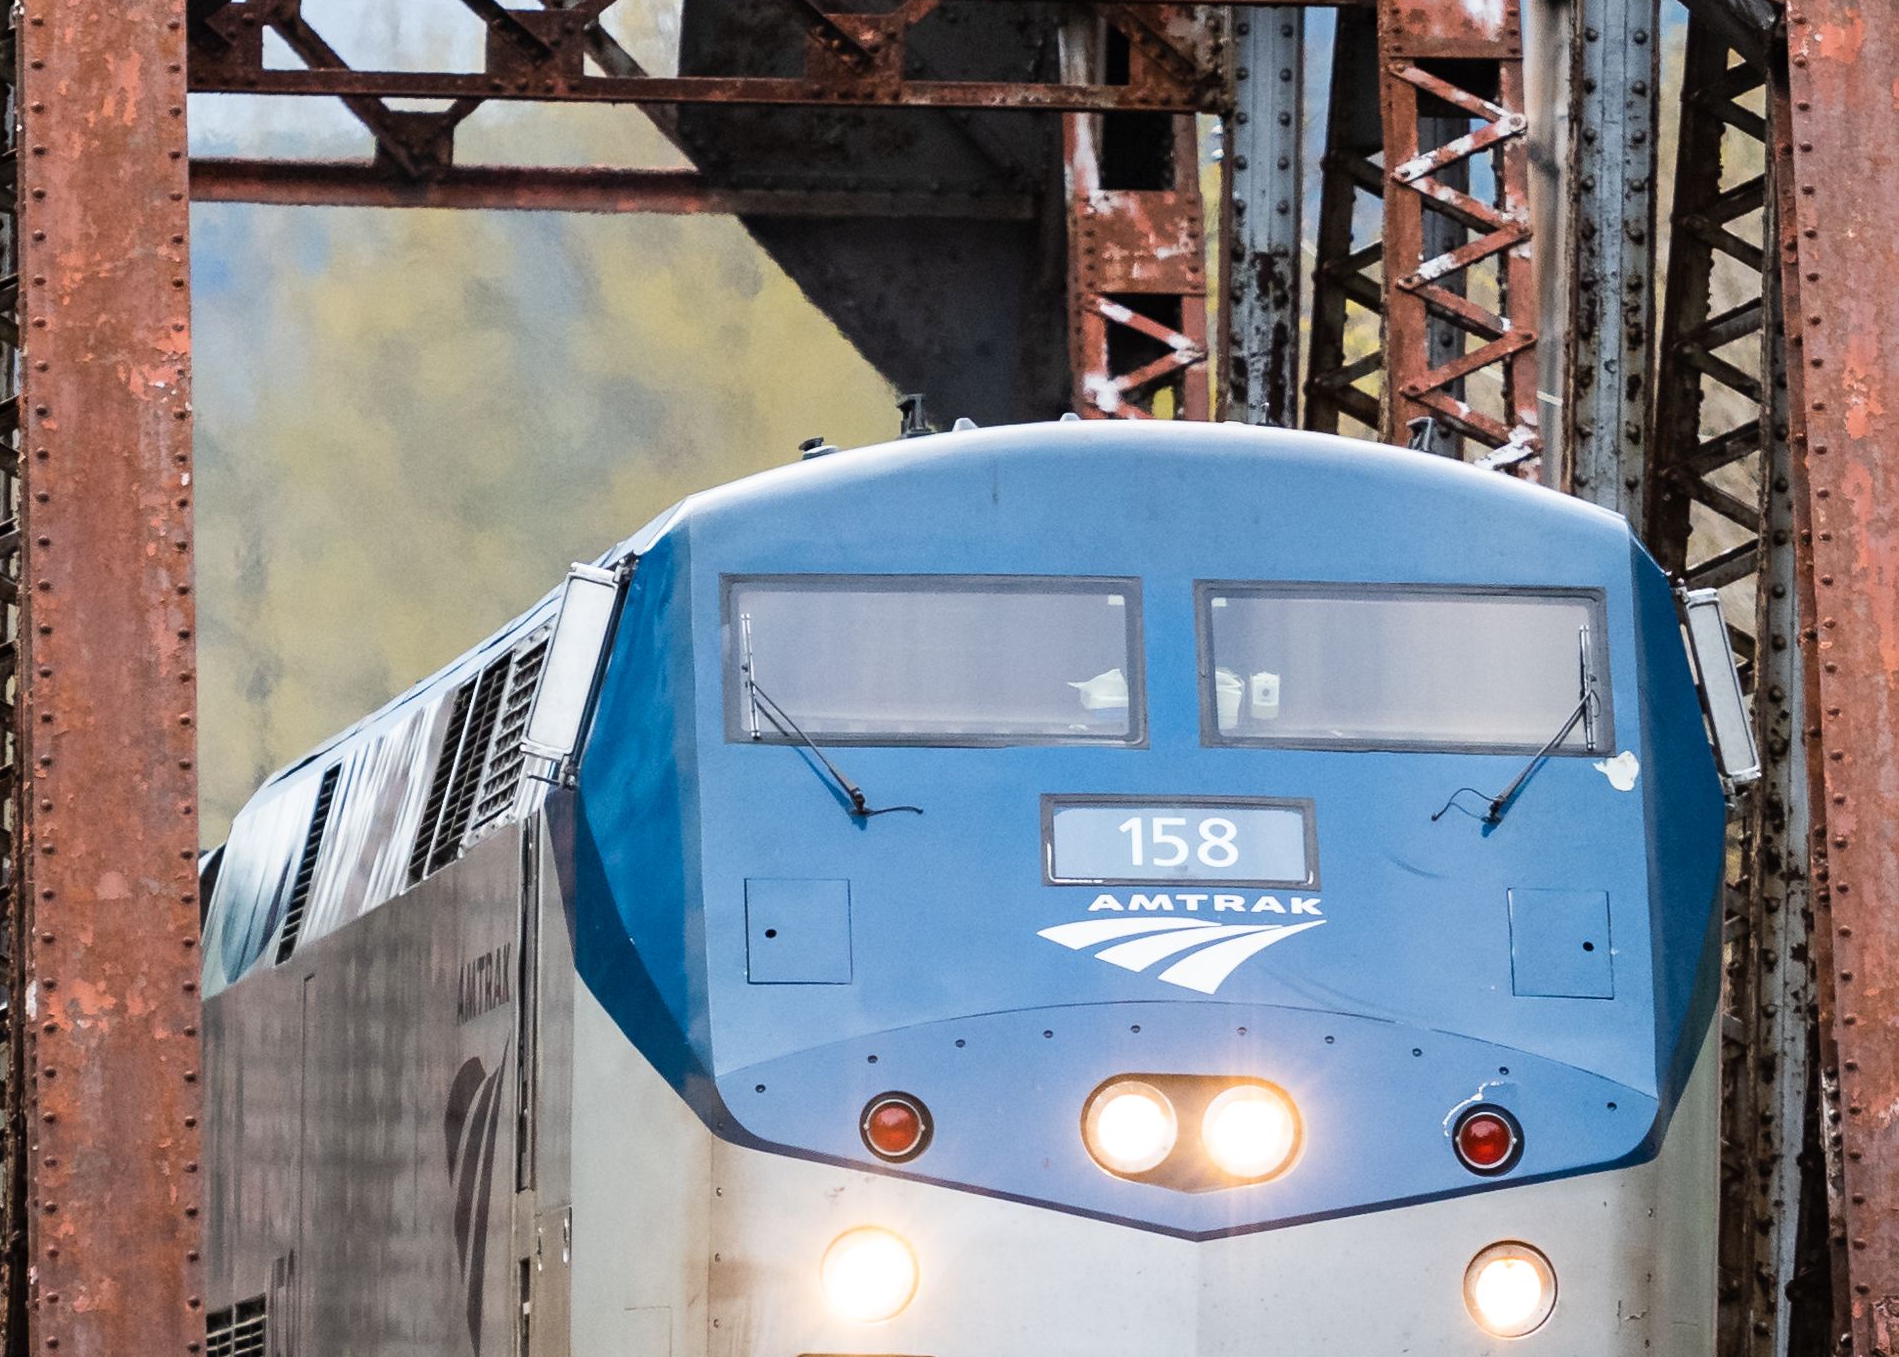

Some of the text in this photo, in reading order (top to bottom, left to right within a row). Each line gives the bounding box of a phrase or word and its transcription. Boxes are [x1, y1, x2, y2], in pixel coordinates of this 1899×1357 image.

[1118, 816, 1239, 868] 158
[1087, 893, 1324, 916] AMTRAK
[457, 942, 511, 1026] AMTRAK
